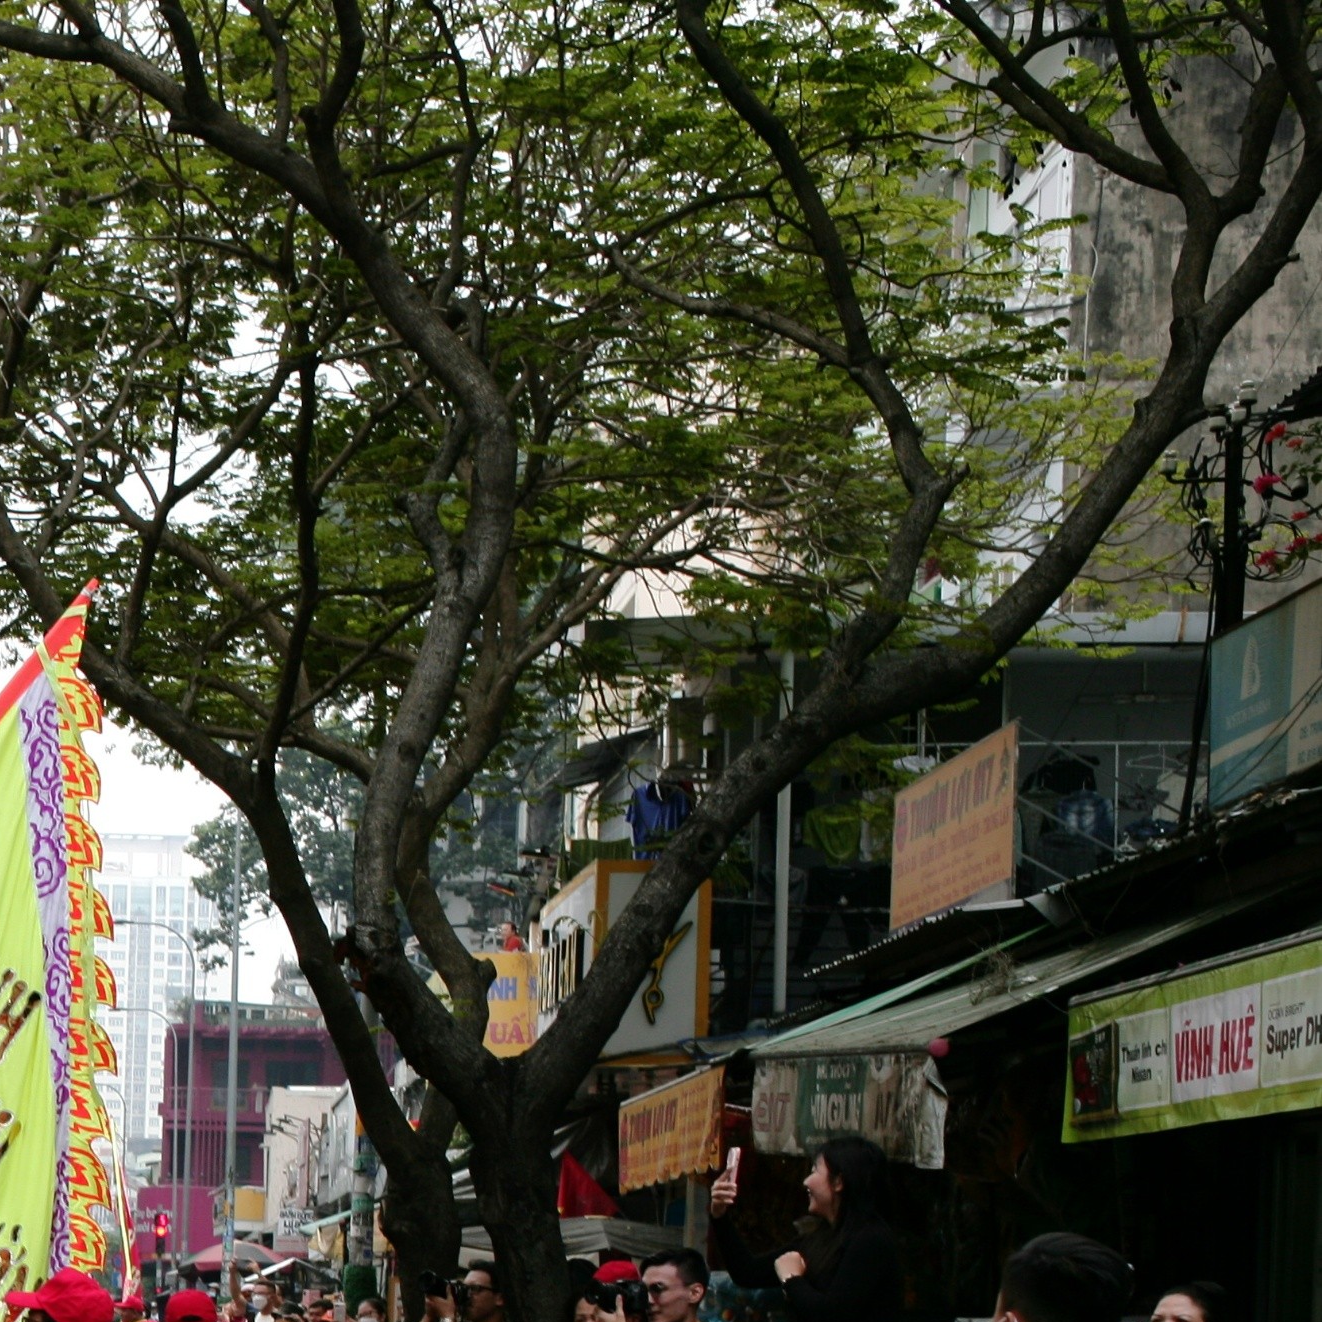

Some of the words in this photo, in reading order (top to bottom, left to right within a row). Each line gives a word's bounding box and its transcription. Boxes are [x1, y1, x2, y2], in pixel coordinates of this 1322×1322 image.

[1174, 1018, 1215, 1084] VĨNH
[1218, 1003, 1256, 1076] HUÊ
[1266, 1023, 1304, 1059] Super
